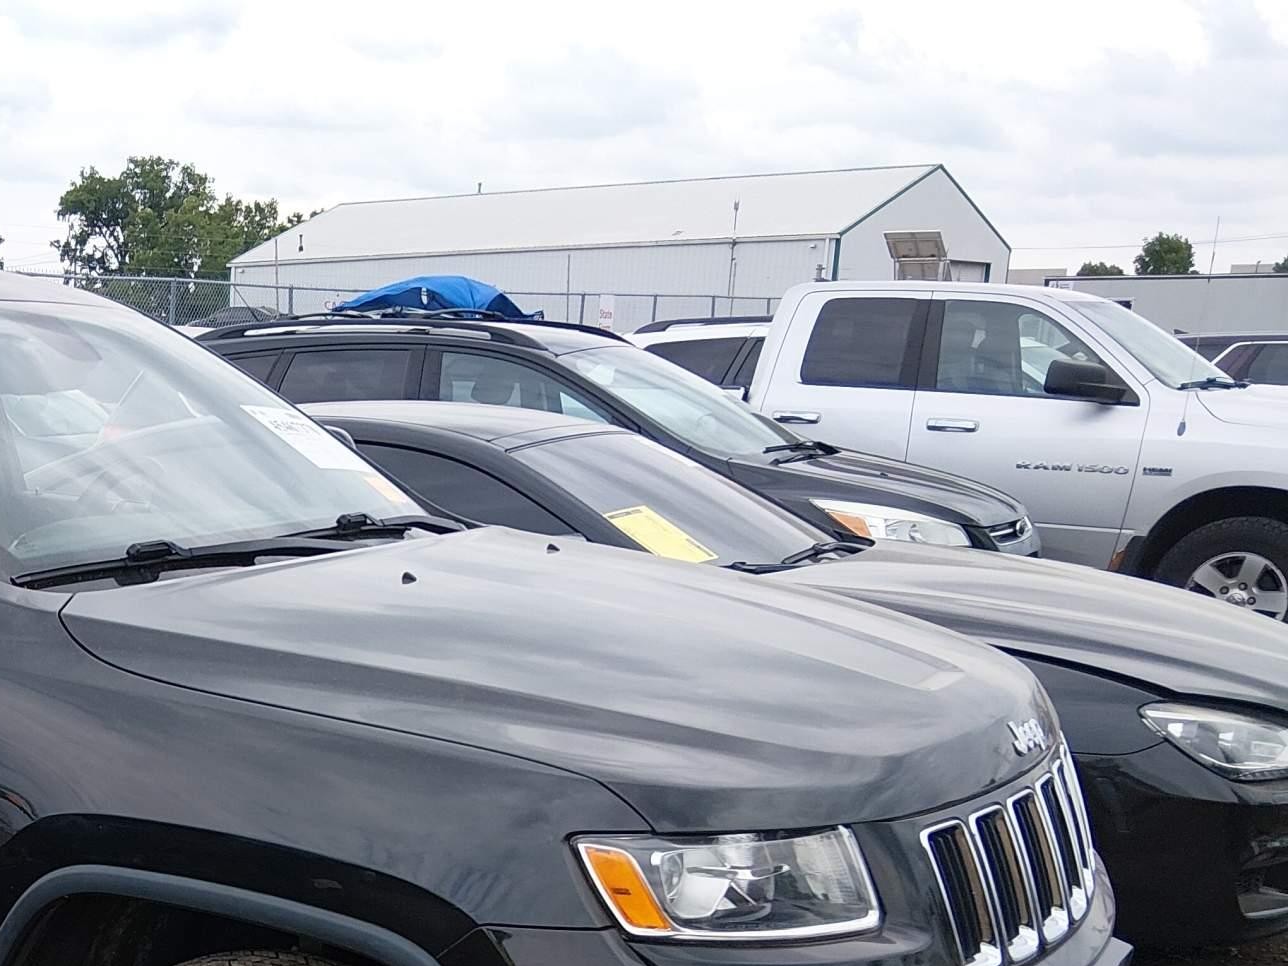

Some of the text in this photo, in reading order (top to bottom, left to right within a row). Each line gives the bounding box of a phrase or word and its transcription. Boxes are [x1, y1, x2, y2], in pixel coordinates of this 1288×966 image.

[1015, 461, 1130, 475] RAM 1500
[1006, 718, 1046, 755] Jeep
